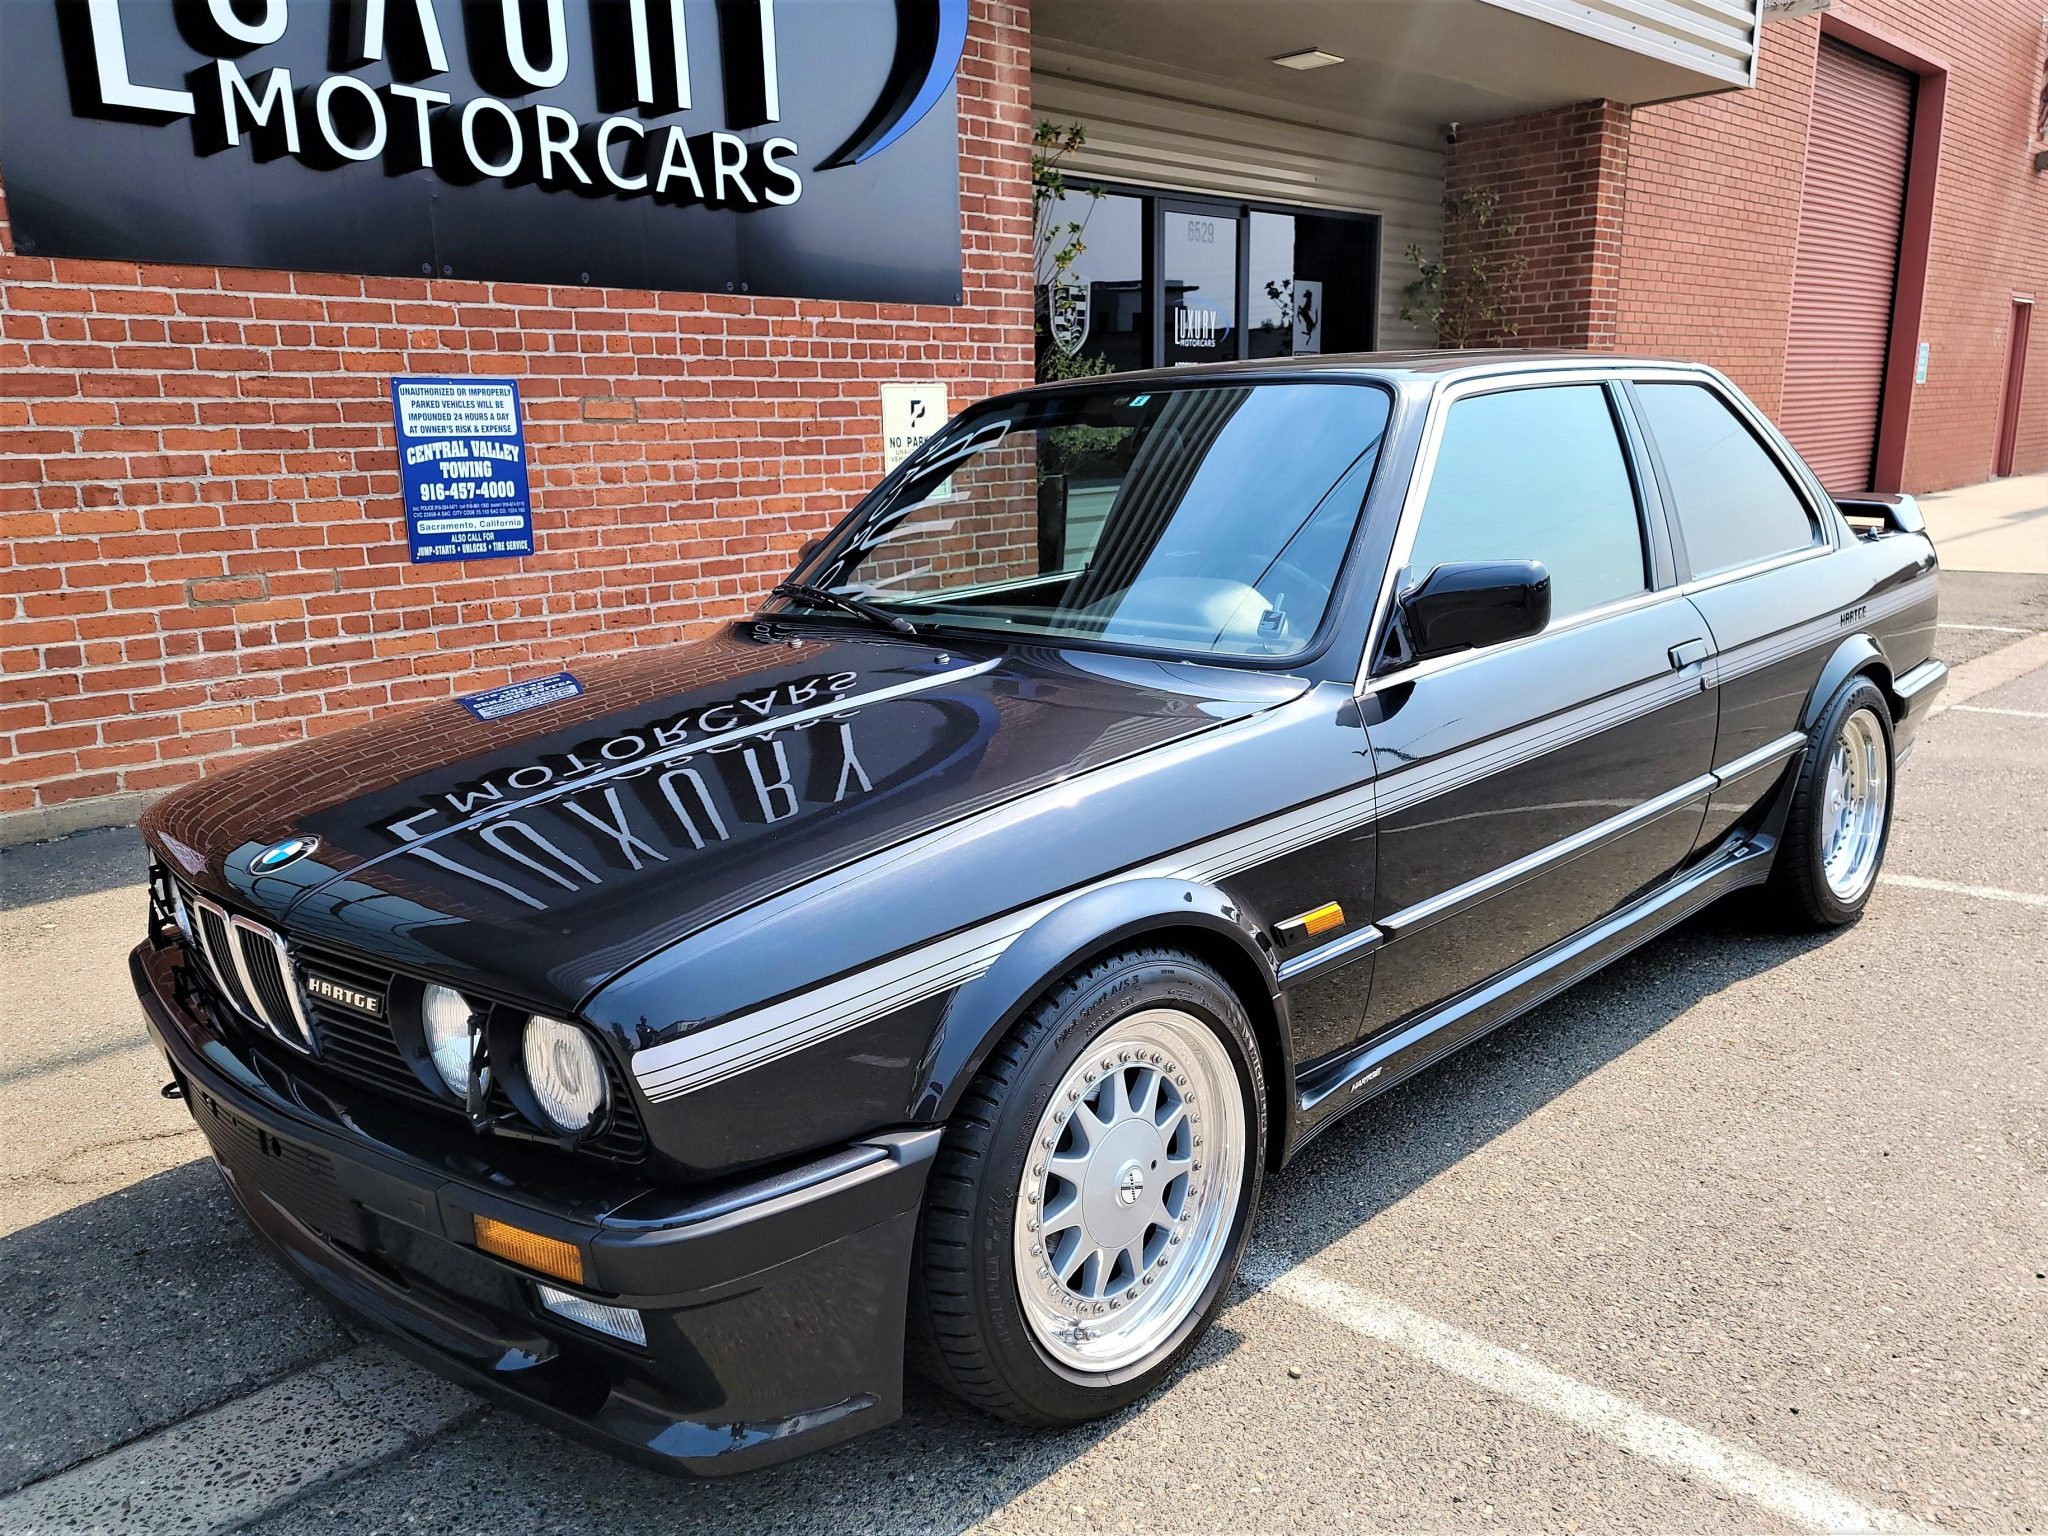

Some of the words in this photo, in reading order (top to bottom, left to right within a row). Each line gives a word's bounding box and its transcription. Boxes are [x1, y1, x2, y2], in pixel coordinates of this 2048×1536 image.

[217, 58, 803, 206] MOTORCARS
[1188, 221, 1214, 243] 6529
[1175, 306, 1216, 344] LUXURY
[1180, 339, 1216, 347] MOTORCARS
[400, 388, 454, 396] UNAUTHORIZED
[457, 388, 466, 396] OR
[468, 388, 511, 396] IMPROPERLY
[408, 413, 451, 421] IMPOUNDED
[890, 437, 902, 448] NO
[406, 440, 468, 465] CENTRAL
[470, 441, 519, 462] VALLEY
[440, 461, 492, 478] TOWING
[420, 481, 515, 501] 916-457-4000
[420, 522, 476, 531] Sacramento,
[480, 519, 521, 528] California
[452, 534, 466, 542] ALSO
[467, 533, 482, 542] CALL
[483, 532, 494, 541] FOR
[417, 545, 456, 556] JUMP-STARTS
[462, 543, 487, 553] UNLOCKS
[493, 542, 505, 551] TIRE
[506, 540, 528, 550] SERVICE
[309, 978, 376, 1011] HARTGE
[1080, 992, 1108, 1018] Sport
